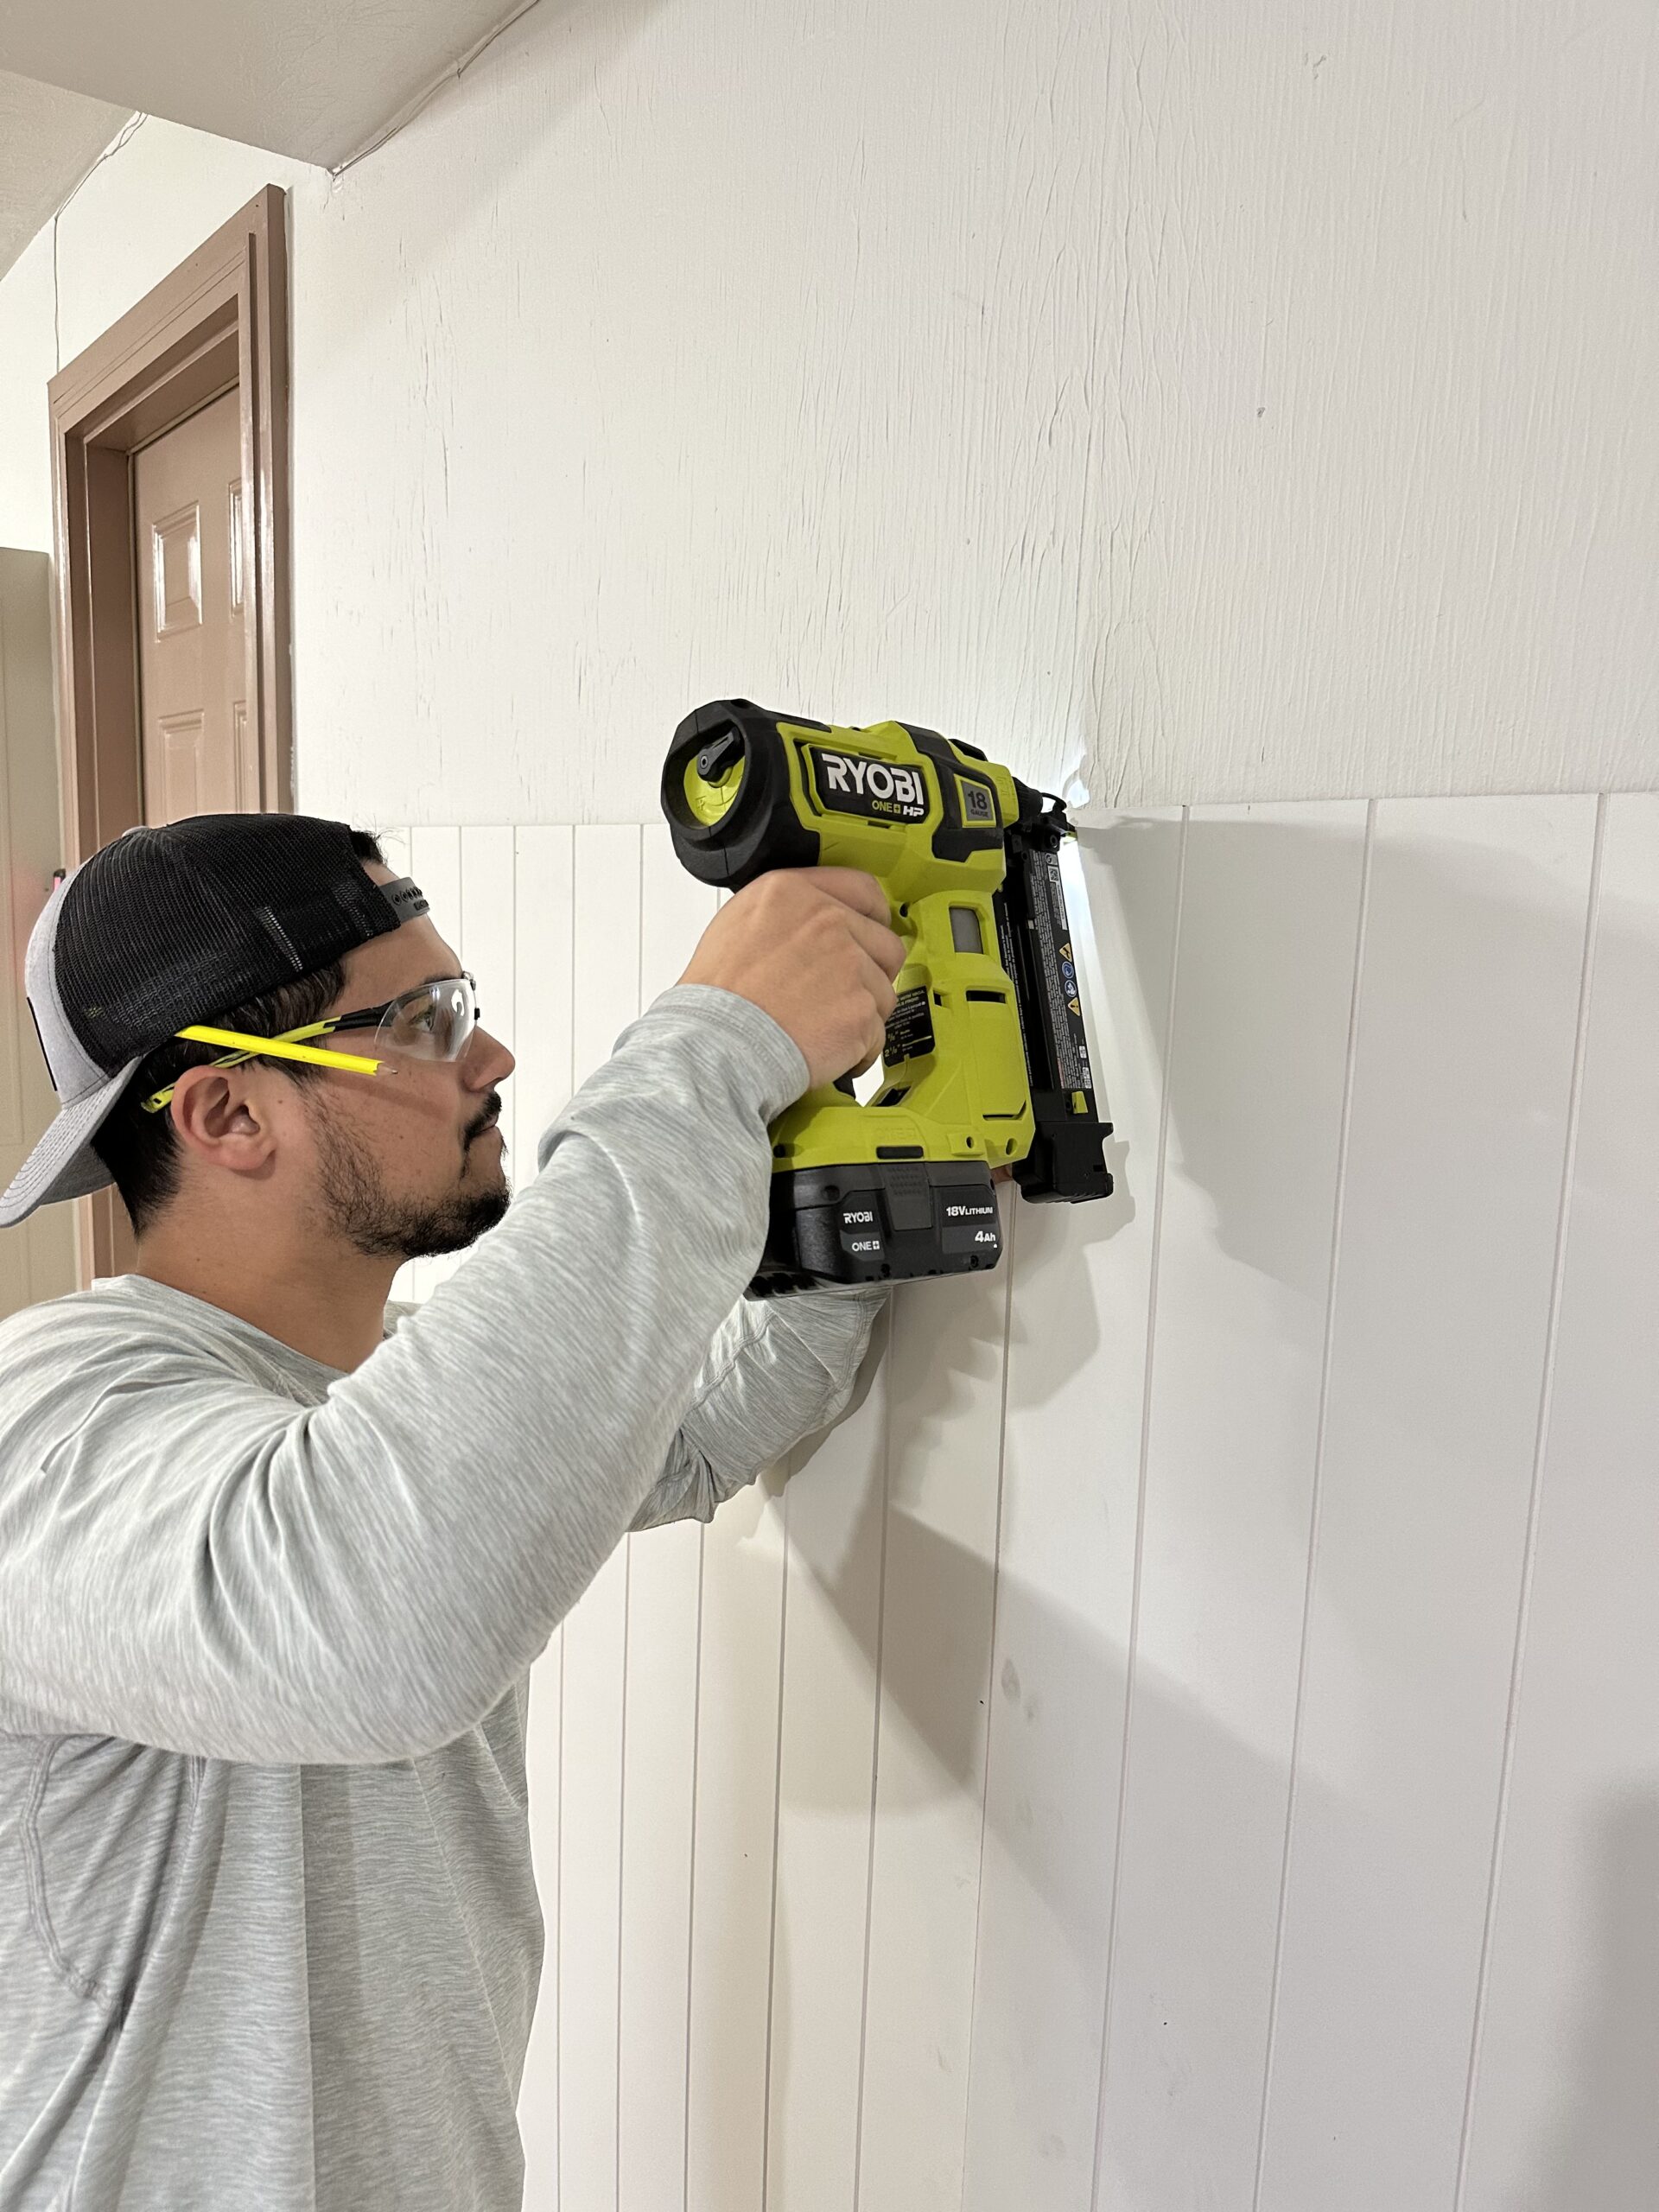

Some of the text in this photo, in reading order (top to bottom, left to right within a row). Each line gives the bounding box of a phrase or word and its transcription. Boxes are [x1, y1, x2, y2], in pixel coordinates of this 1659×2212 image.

[821, 753, 925, 805] RYOBI
[968, 790, 988, 810] 18
[902, 805, 925, 817] HP
[970, 809, 988, 817] GAUGE
[842, 1211, 874, 1224] RYOBI
[975, 1230, 996, 1243] 4Ah
